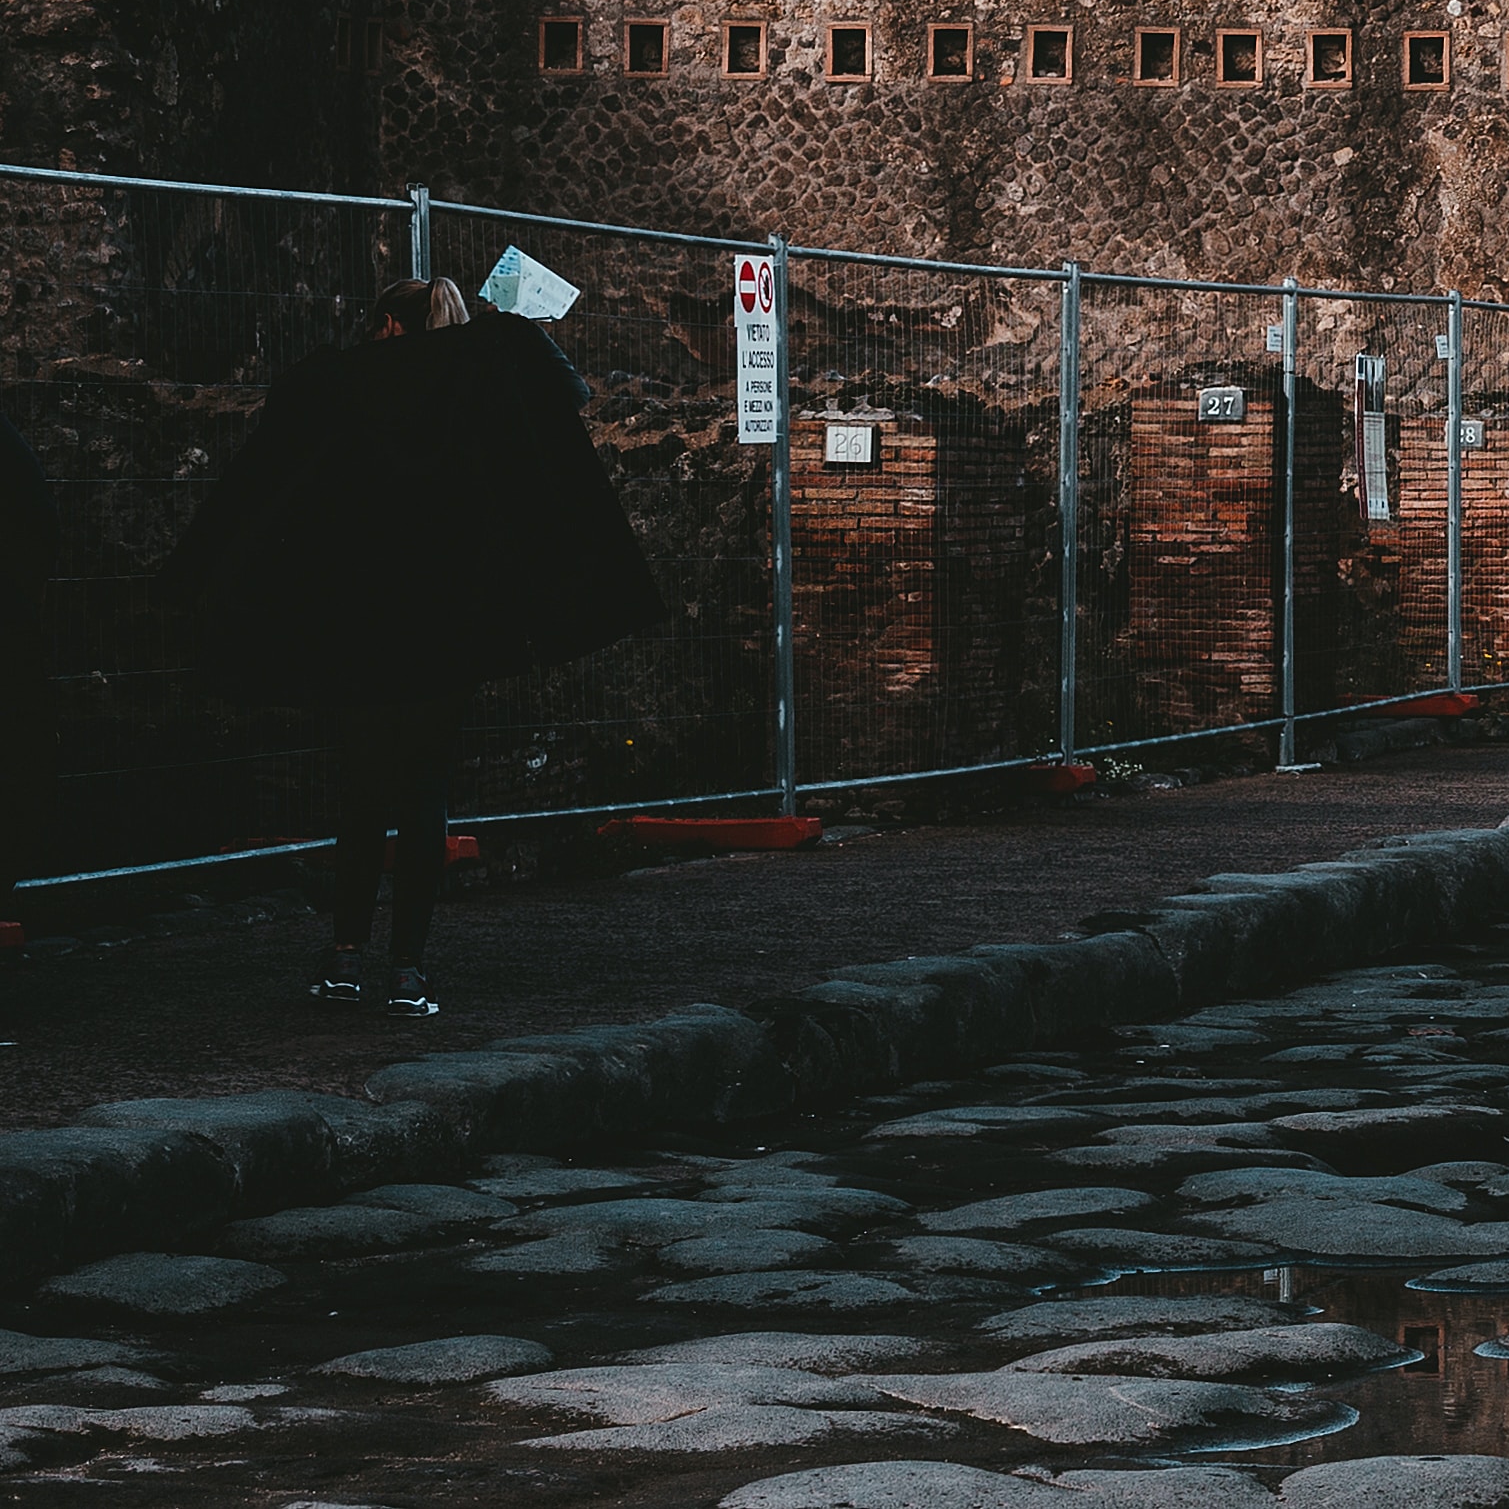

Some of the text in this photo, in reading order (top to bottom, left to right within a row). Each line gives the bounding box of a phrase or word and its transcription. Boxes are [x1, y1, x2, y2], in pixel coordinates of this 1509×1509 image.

[746, 323, 771, 341] VIETATO
[742, 350, 775, 368] L'ACCESSO
[751, 380, 773, 393] PERSONE
[744, 400, 774, 413] E MEZZI NON
[1207, 396, 1235, 415] 27
[834, 433, 864, 456] 26
